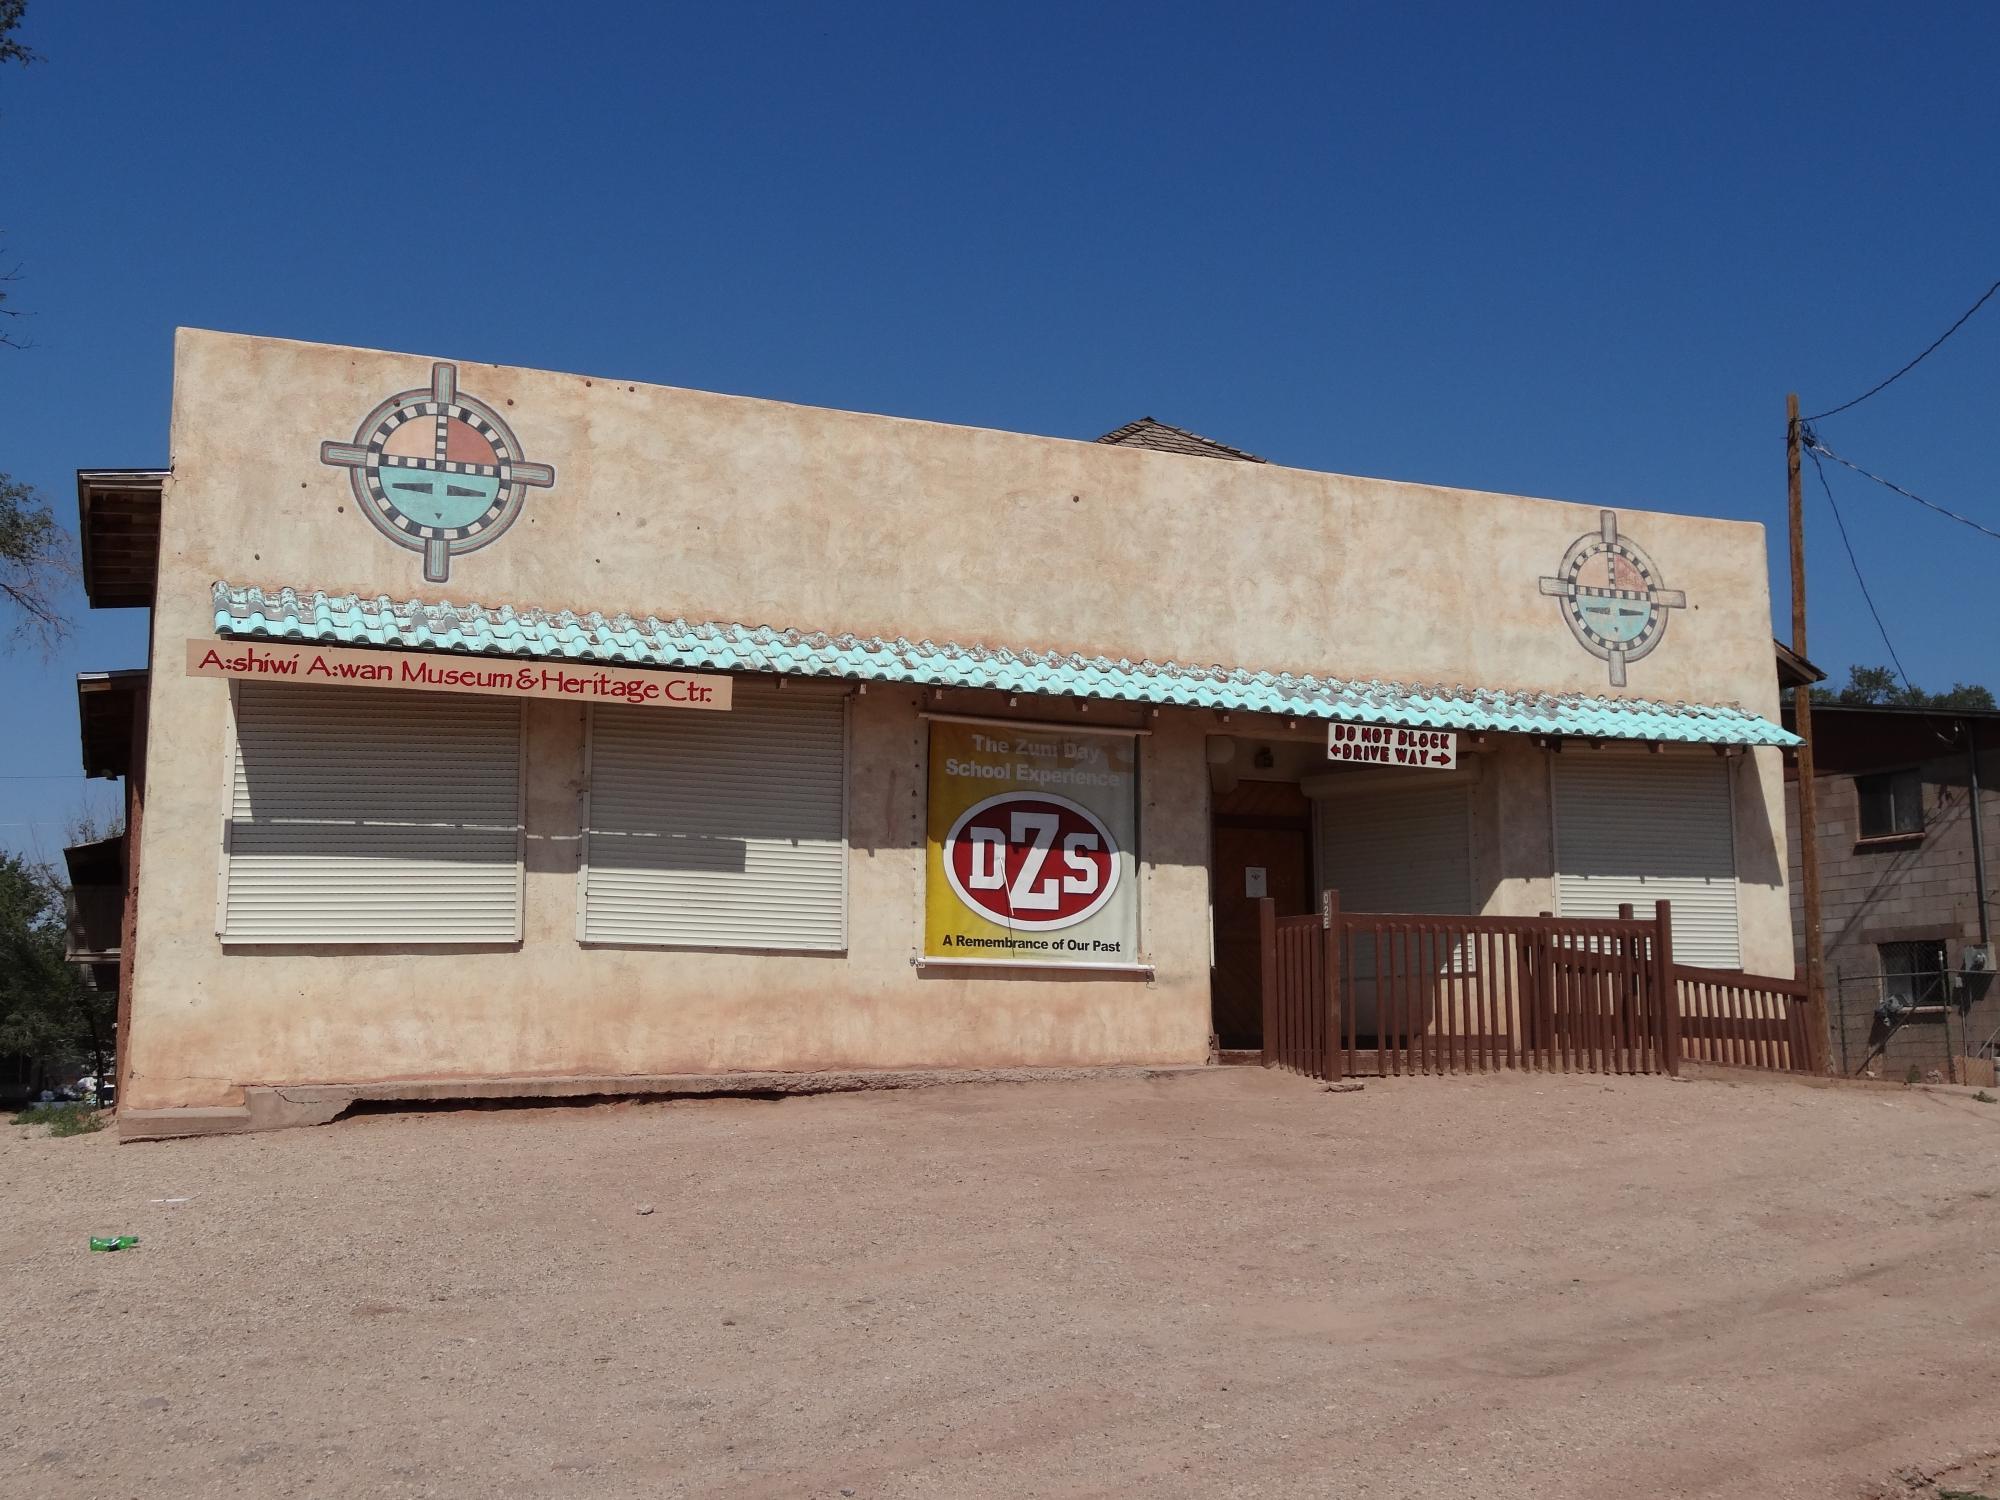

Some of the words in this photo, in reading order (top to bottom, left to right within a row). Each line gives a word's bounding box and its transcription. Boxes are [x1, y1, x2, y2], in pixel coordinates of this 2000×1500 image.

[198, 648, 300, 675] A:shiwi
[306, 655, 393, 681] A:wan
[401, 660, 513, 688] Museum
[541, 669, 660, 703] Heritage
[664, 680, 713, 703] Ctr.
[971, 734, 1010, 754] The
[1063, 742, 1100, 764] Day
[1334, 724, 1357, 742] DO
[1361, 727, 1393, 745] NOT
[1397, 729, 1450, 750] BLOCK
[1342, 743, 1390, 762] DRIVE
[1395, 748, 1429, 765] WAY
[945, 758, 1011, 780] School
[1016, 764, 1121, 787] Experience
[969, 811, 1100, 911] DZS
[942, 935, 953, 946] A
[956, 935, 1049, 950] Remembrance
[1052, 938, 1065, 950] of
[1067, 939, 1090, 951] Our
[1092, 940, 1121, 952] Past
